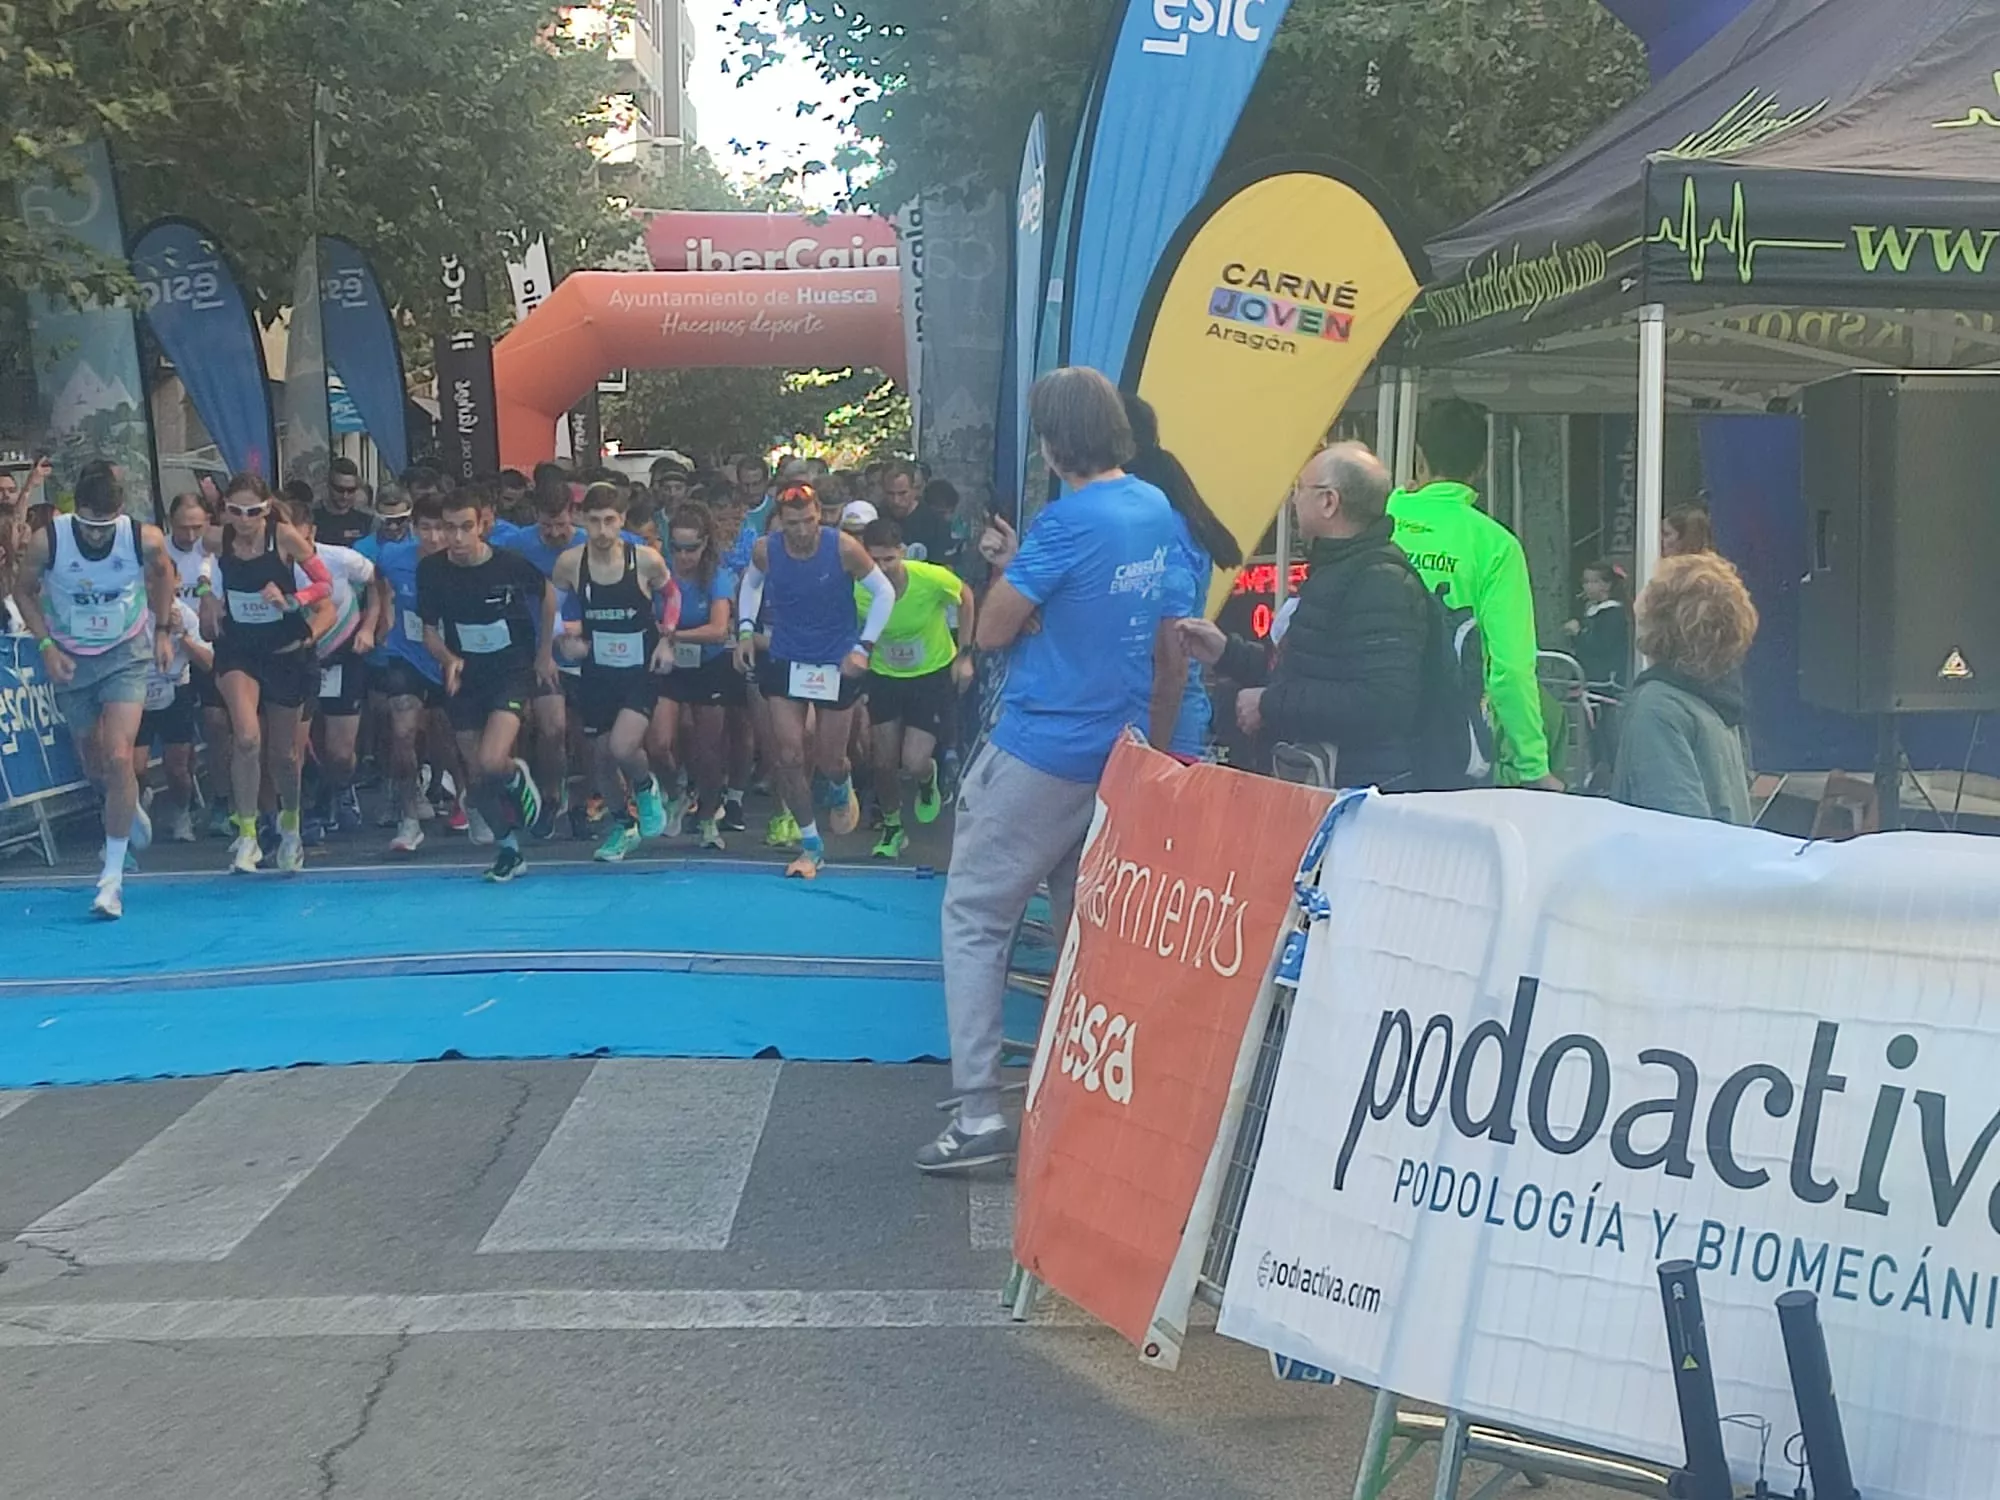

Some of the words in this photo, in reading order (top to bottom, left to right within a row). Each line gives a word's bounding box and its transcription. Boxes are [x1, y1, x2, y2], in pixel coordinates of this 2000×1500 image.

[608, 288, 759, 309] Ayuntamiento
[764, 288, 791, 305] de
[796, 286, 877, 305] Huesca
[1222, 263, 1358, 310] CARNÉ
[660, 311, 748, 337] Hacemos
[749, 312, 825, 341] deporte
[1206, 322, 1297, 355] Aragón
[1213, 292, 1351, 339] JOVEN
[1333, 975, 2000, 1234] podoactiv
[1394, 1158, 1626, 1253] PODOLOGÍA
[1652, 1210, 1678, 1260] Y
